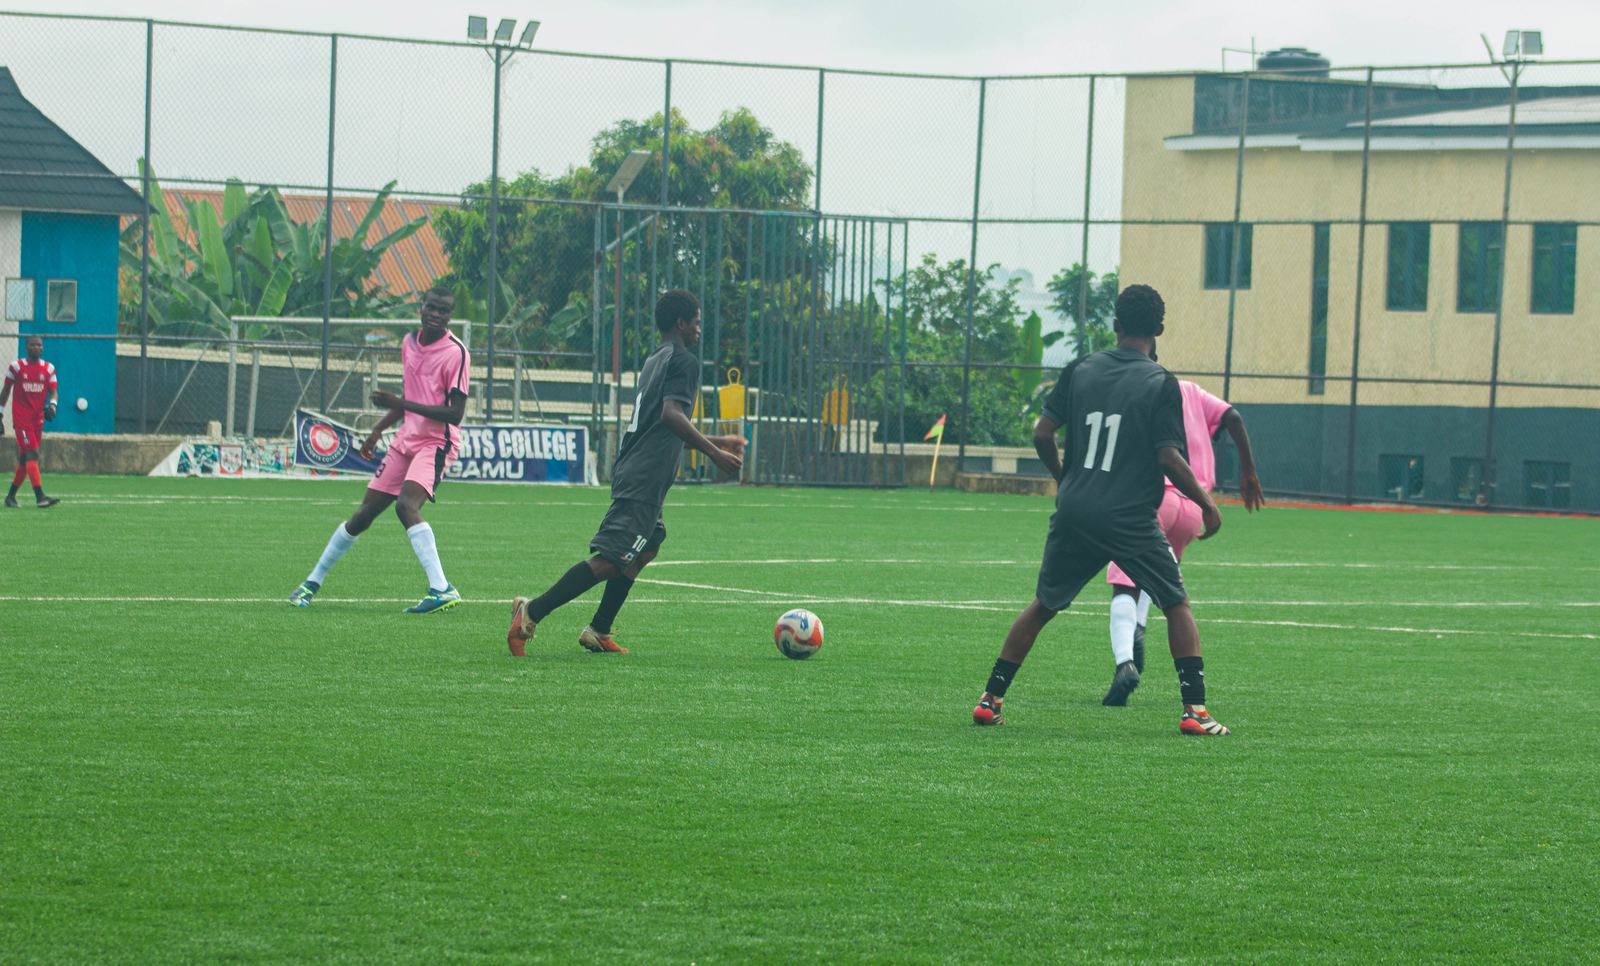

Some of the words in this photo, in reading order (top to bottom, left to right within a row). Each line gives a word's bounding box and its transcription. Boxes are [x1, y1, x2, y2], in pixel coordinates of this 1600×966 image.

[460, 429, 495, 459] RTS
[498, 430, 577, 461] COLLEGE
[1083, 411, 1122, 472] 11
[446, 460, 524, 479] GAMU
[632, 535, 647, 552] 10
